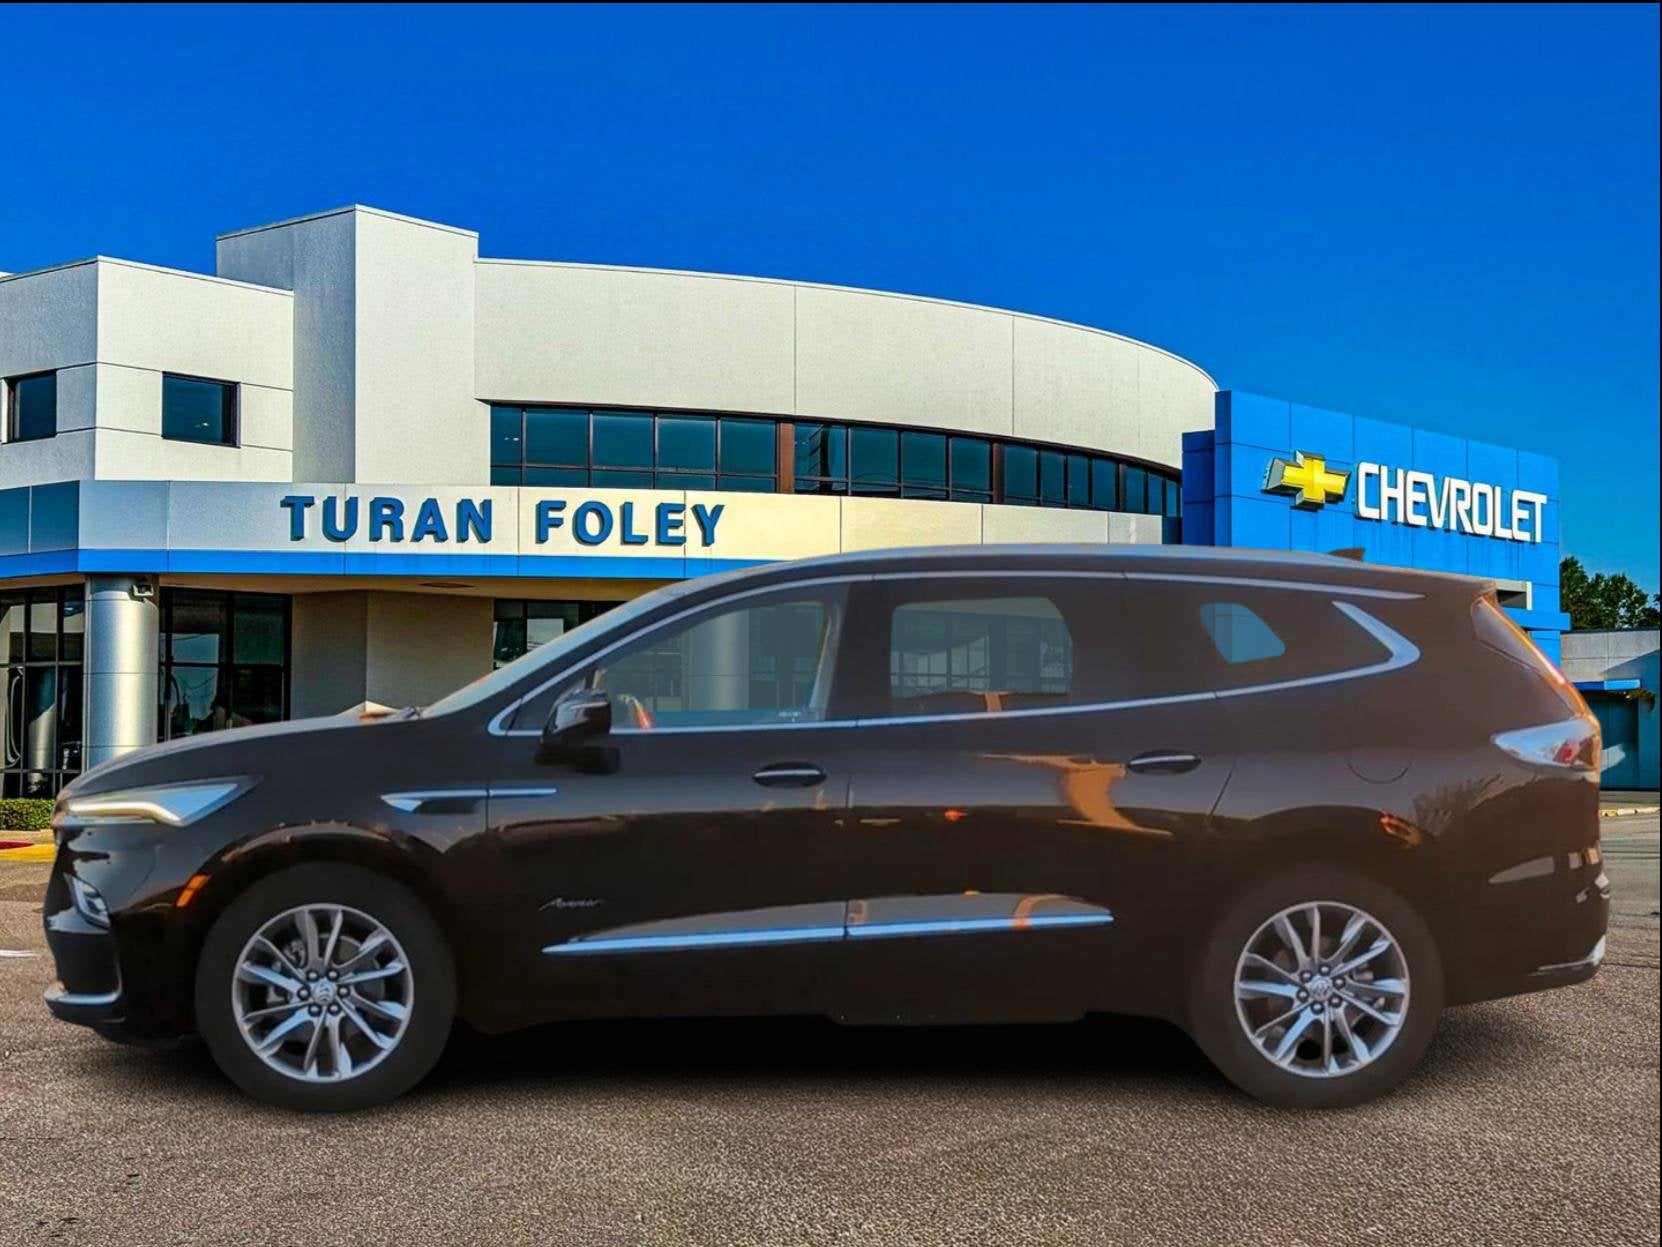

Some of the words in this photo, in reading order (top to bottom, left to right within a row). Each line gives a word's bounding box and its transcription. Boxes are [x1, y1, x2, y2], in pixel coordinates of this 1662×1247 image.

[280, 496, 492, 542] TURAN
[535, 500, 725, 546] FOLEY
[1357, 462, 1548, 543] CHEVROLET
